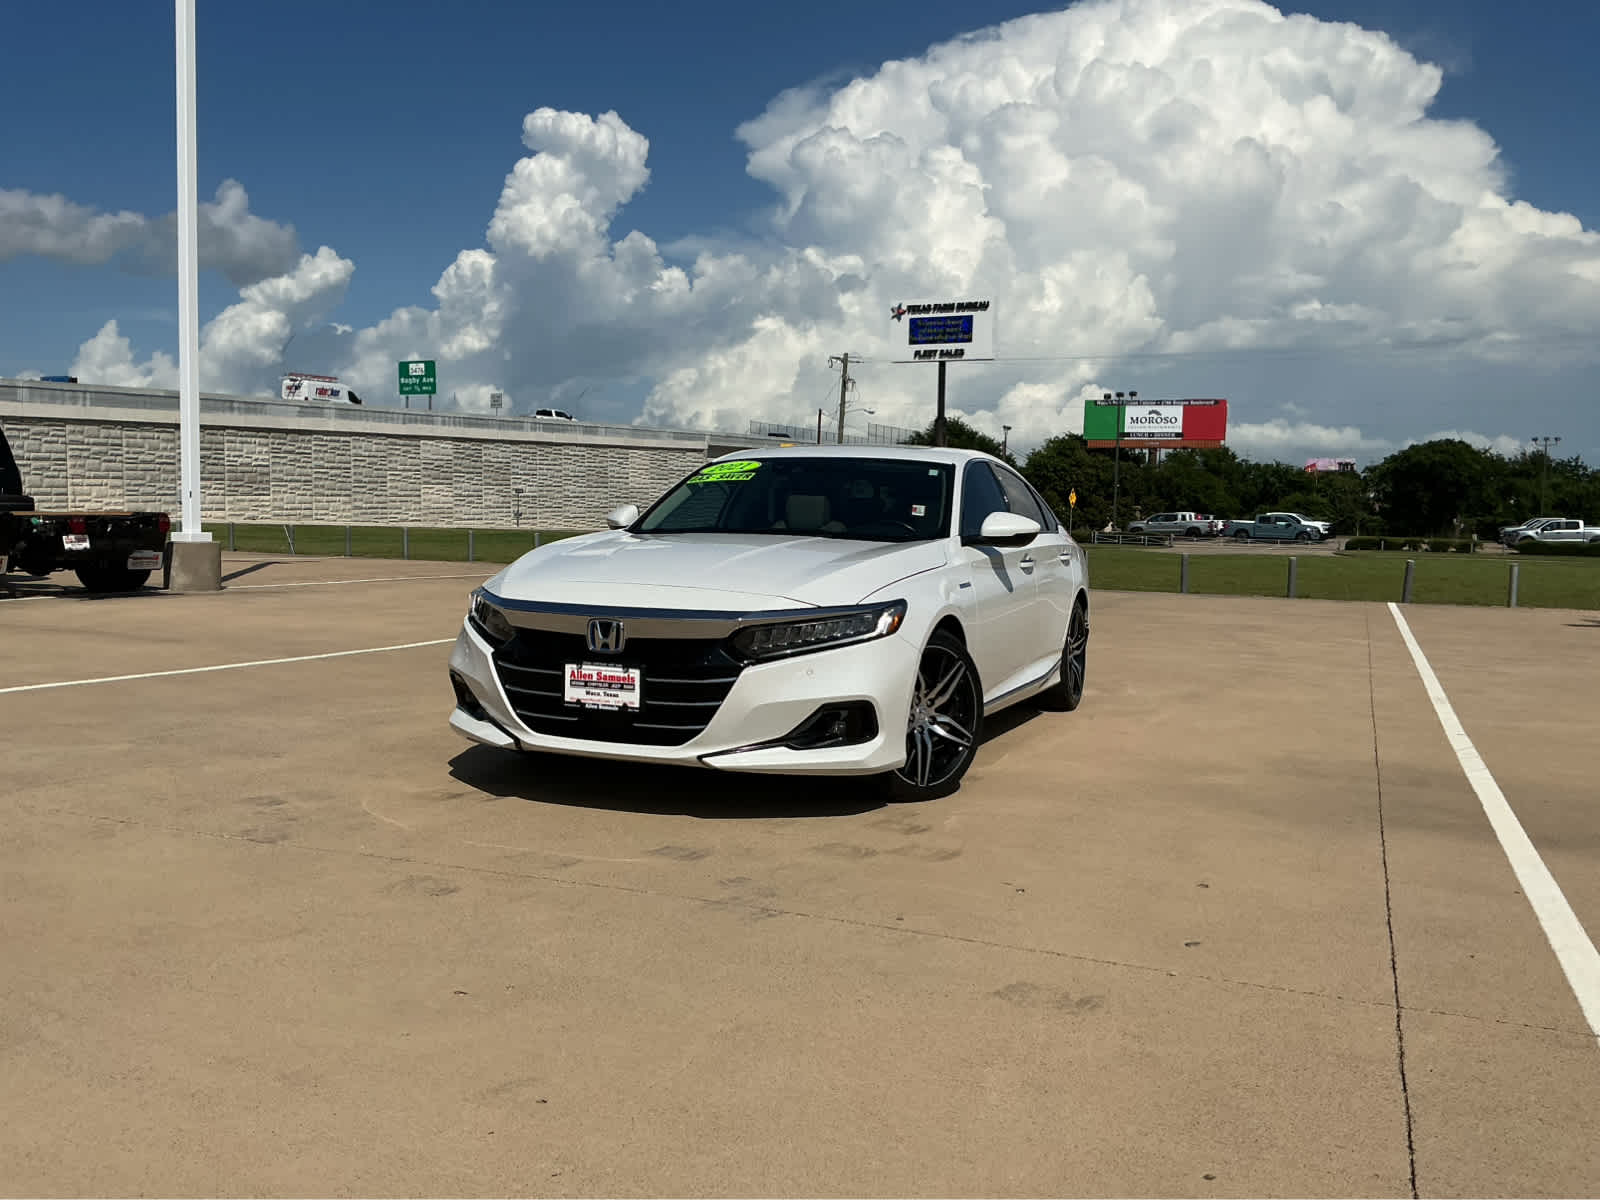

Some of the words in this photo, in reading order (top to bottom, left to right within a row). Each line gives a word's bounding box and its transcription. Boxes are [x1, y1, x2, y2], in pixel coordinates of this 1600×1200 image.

[907, 304, 931, 314] TEXAS
[932, 303, 955, 313] FARM
[956, 301, 990, 312] BUREAU
[914, 350, 937, 360] FLEET
[938, 349, 964, 359] SALES
[1130, 416, 1178, 425] MOROSO
[570, 670, 593, 680] Allen
[596, 672, 635, 684] Samuels
